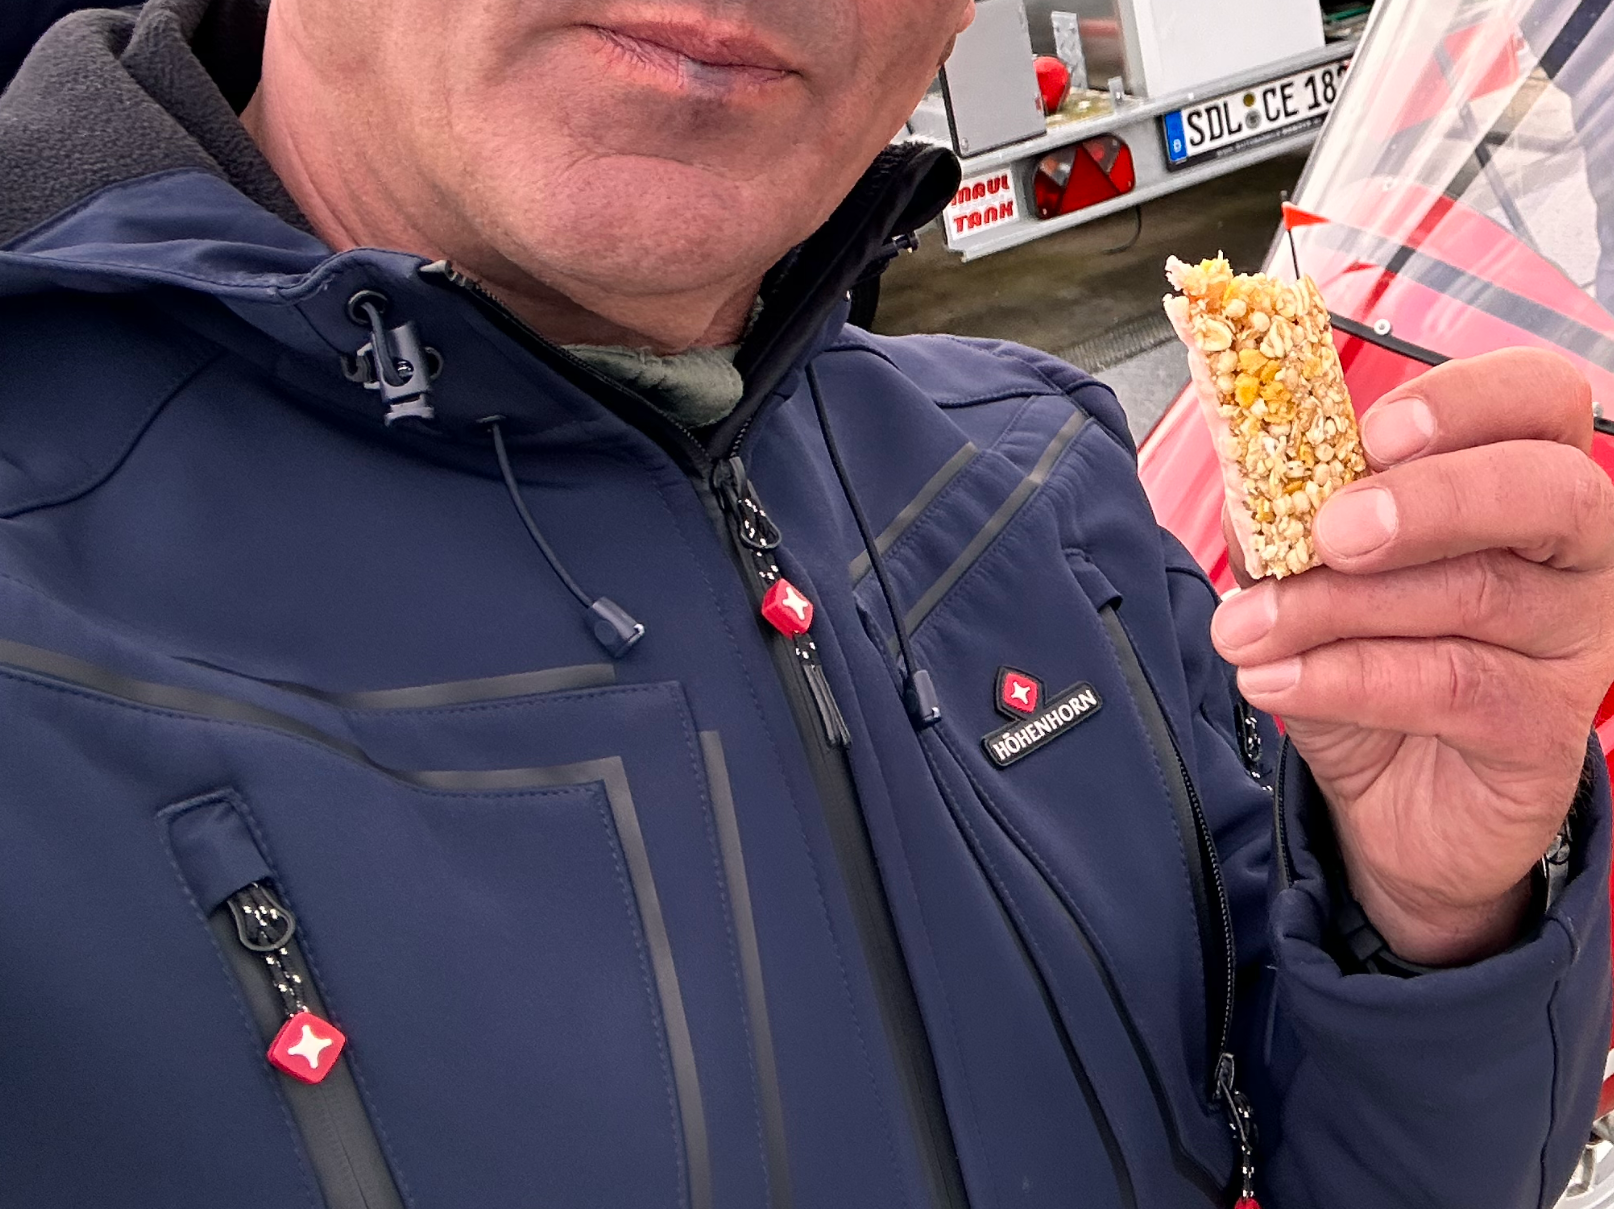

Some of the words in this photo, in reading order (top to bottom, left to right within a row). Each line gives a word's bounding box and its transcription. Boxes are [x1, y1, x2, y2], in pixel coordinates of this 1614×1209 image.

[1187, 100, 1243, 146] SDL
[1263, 82, 1298, 122] CE
[953, 200, 1014, 233] TANK
[993, 689, 1097, 761] HÖHENHORN
